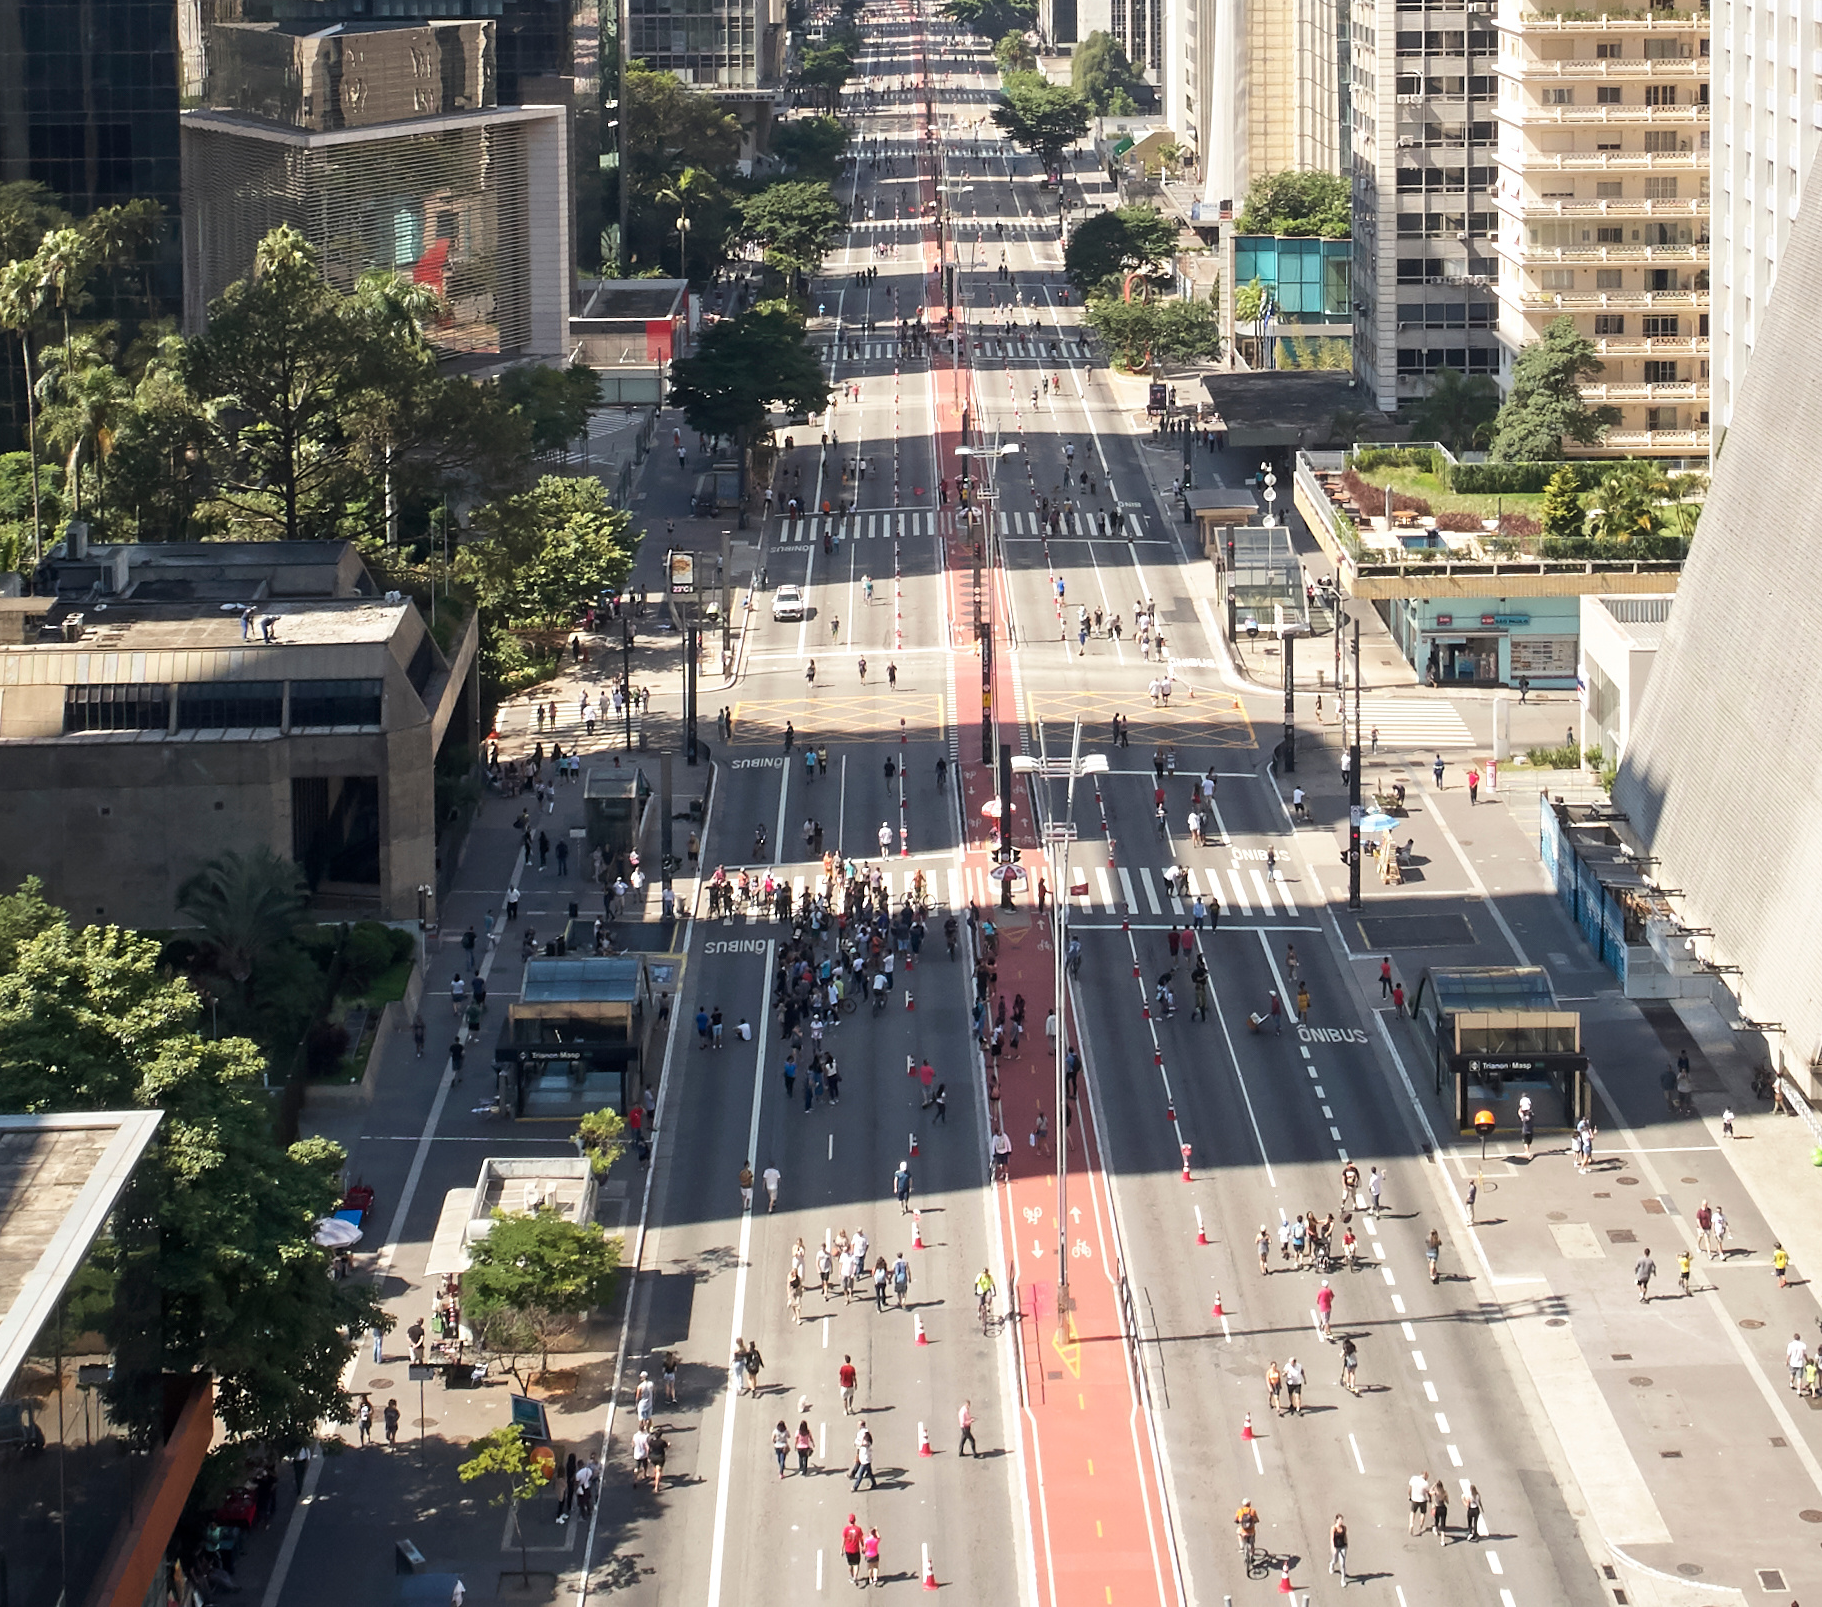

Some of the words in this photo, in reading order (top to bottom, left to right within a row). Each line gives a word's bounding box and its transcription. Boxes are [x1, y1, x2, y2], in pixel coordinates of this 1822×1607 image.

[731, 757, 783, 769] ÔNIBUS
[704, 939, 766, 955] ÔNIBUS
[1296, 1023, 1368, 1044] ÔNIBUS
[1512, 1061, 1532, 1070] Masp
